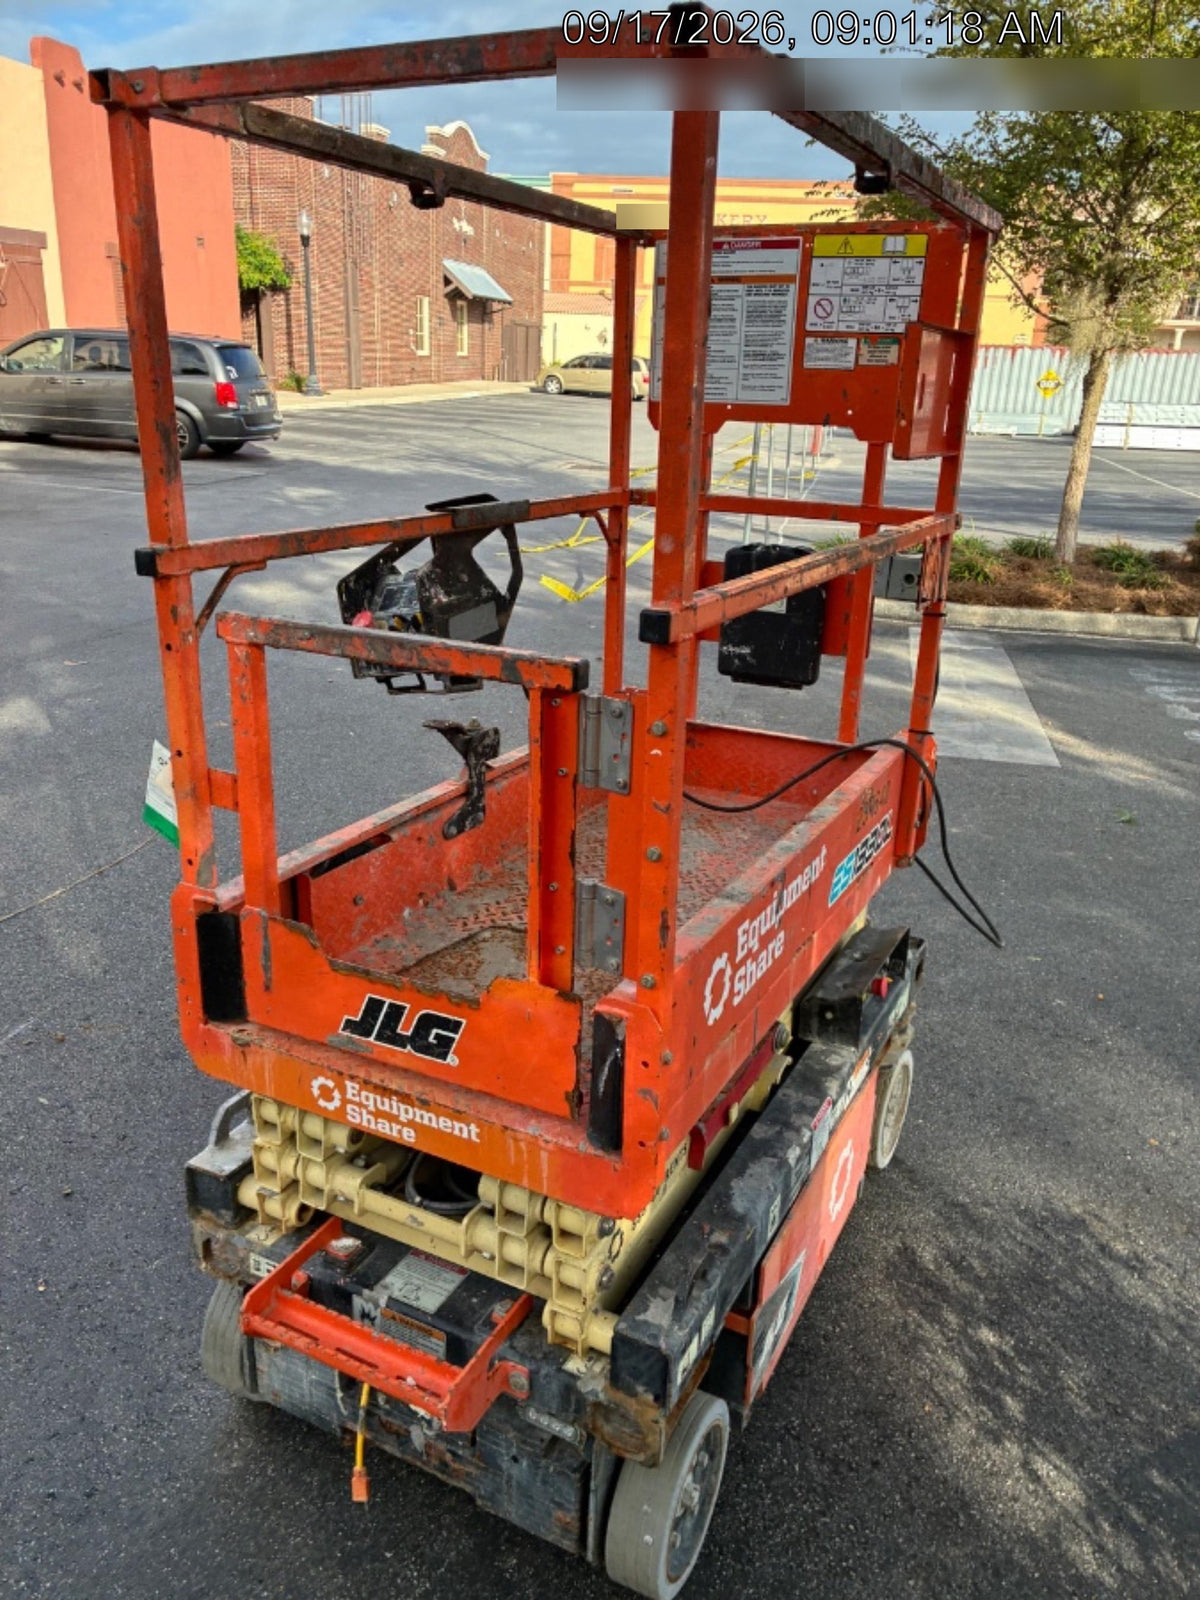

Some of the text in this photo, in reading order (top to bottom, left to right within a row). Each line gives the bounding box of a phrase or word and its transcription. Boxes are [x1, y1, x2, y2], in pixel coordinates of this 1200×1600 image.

[716, 213, 768, 226] KERY
[732, 929, 786, 1007] Share
[338, 993, 467, 1064] JLG
[344, 1080, 481, 1143] Equipment
[346, 1104, 416, 1143] Share
